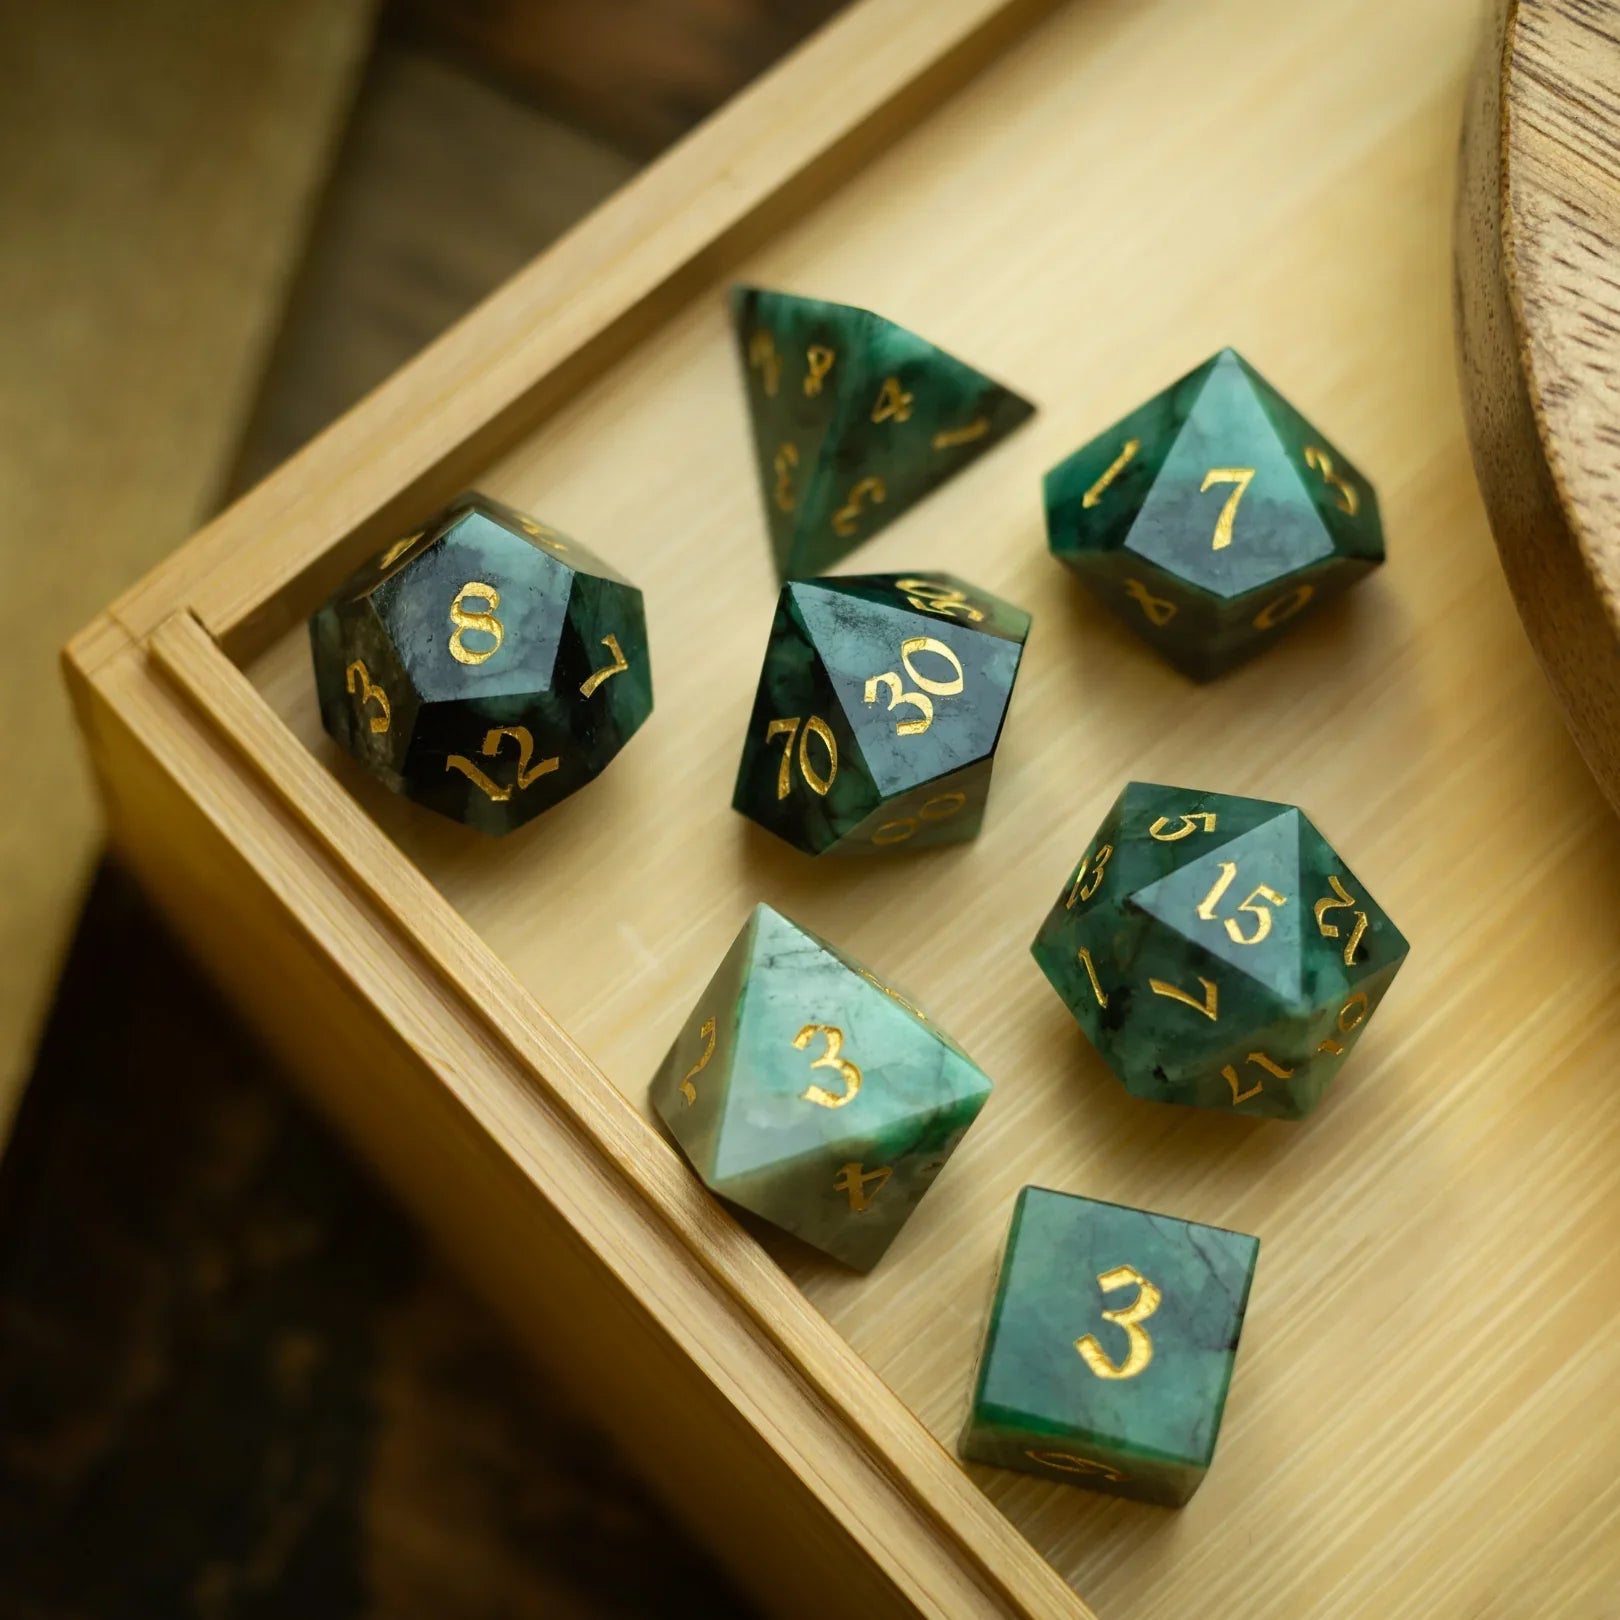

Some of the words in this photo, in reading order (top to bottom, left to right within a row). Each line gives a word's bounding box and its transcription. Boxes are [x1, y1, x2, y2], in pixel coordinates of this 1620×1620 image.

[871, 377, 914, 424] 4
[1082, 439, 1139, 508] 1
[1201, 469, 1255, 551] 7
[1305, 447, 1358, 516] 3
[449, 582, 504, 665] 8
[346, 660, 391, 733] 3
[864, 637, 964, 736] 30
[447, 726, 560, 801] 12
[765, 715, 837, 800] 70
[1149, 812, 1217, 841] 5
[1065, 844, 1114, 910] 13
[1197, 862, 1287, 944] 15
[1314, 876, 1369, 966] 12
[1079, 947, 1108, 1009] 1
[1149, 976, 1218, 1022] 7
[791, 1024, 862, 1110] 3
[1221, 1052, 1295, 1105] 17
[832, 1162, 894, 1211] 4
[1074, 1264, 1161, 1380] 3
